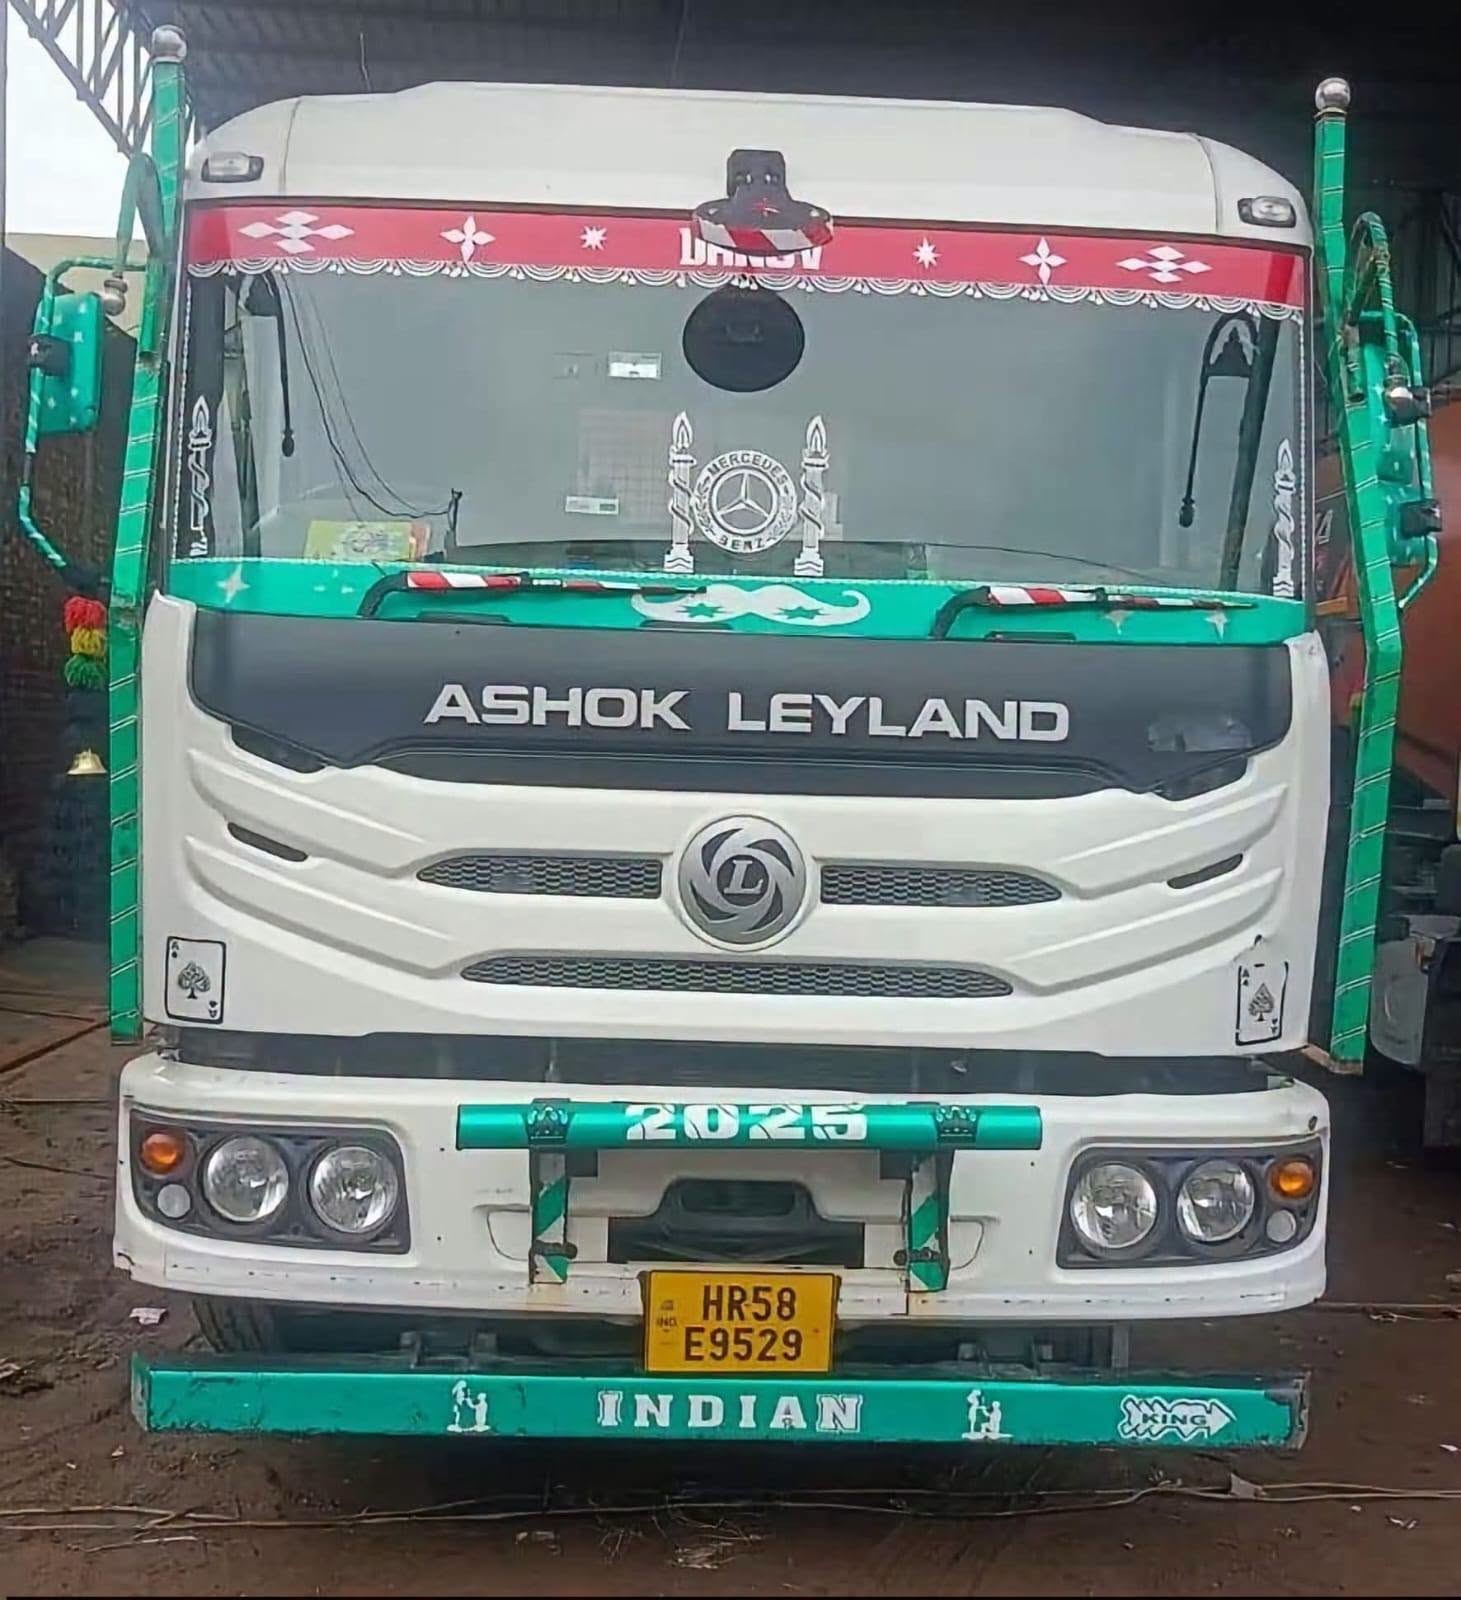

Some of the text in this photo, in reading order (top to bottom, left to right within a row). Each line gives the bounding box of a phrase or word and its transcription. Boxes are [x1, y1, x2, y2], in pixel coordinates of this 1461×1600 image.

[707, 452, 788, 484] MERCEDES
[718, 535, 766, 550] BENZ
[424, 684, 1069, 742] ASHOK LEYLAND
[723, 859, 764, 895] L
[624, 1103, 868, 1141] 2025
[702, 1284, 797, 1322] HR58
[684, 1326, 803, 1362] E9529
[597, 1391, 863, 1433] INDIAN
[1142, 1413, 1208, 1426] KING
